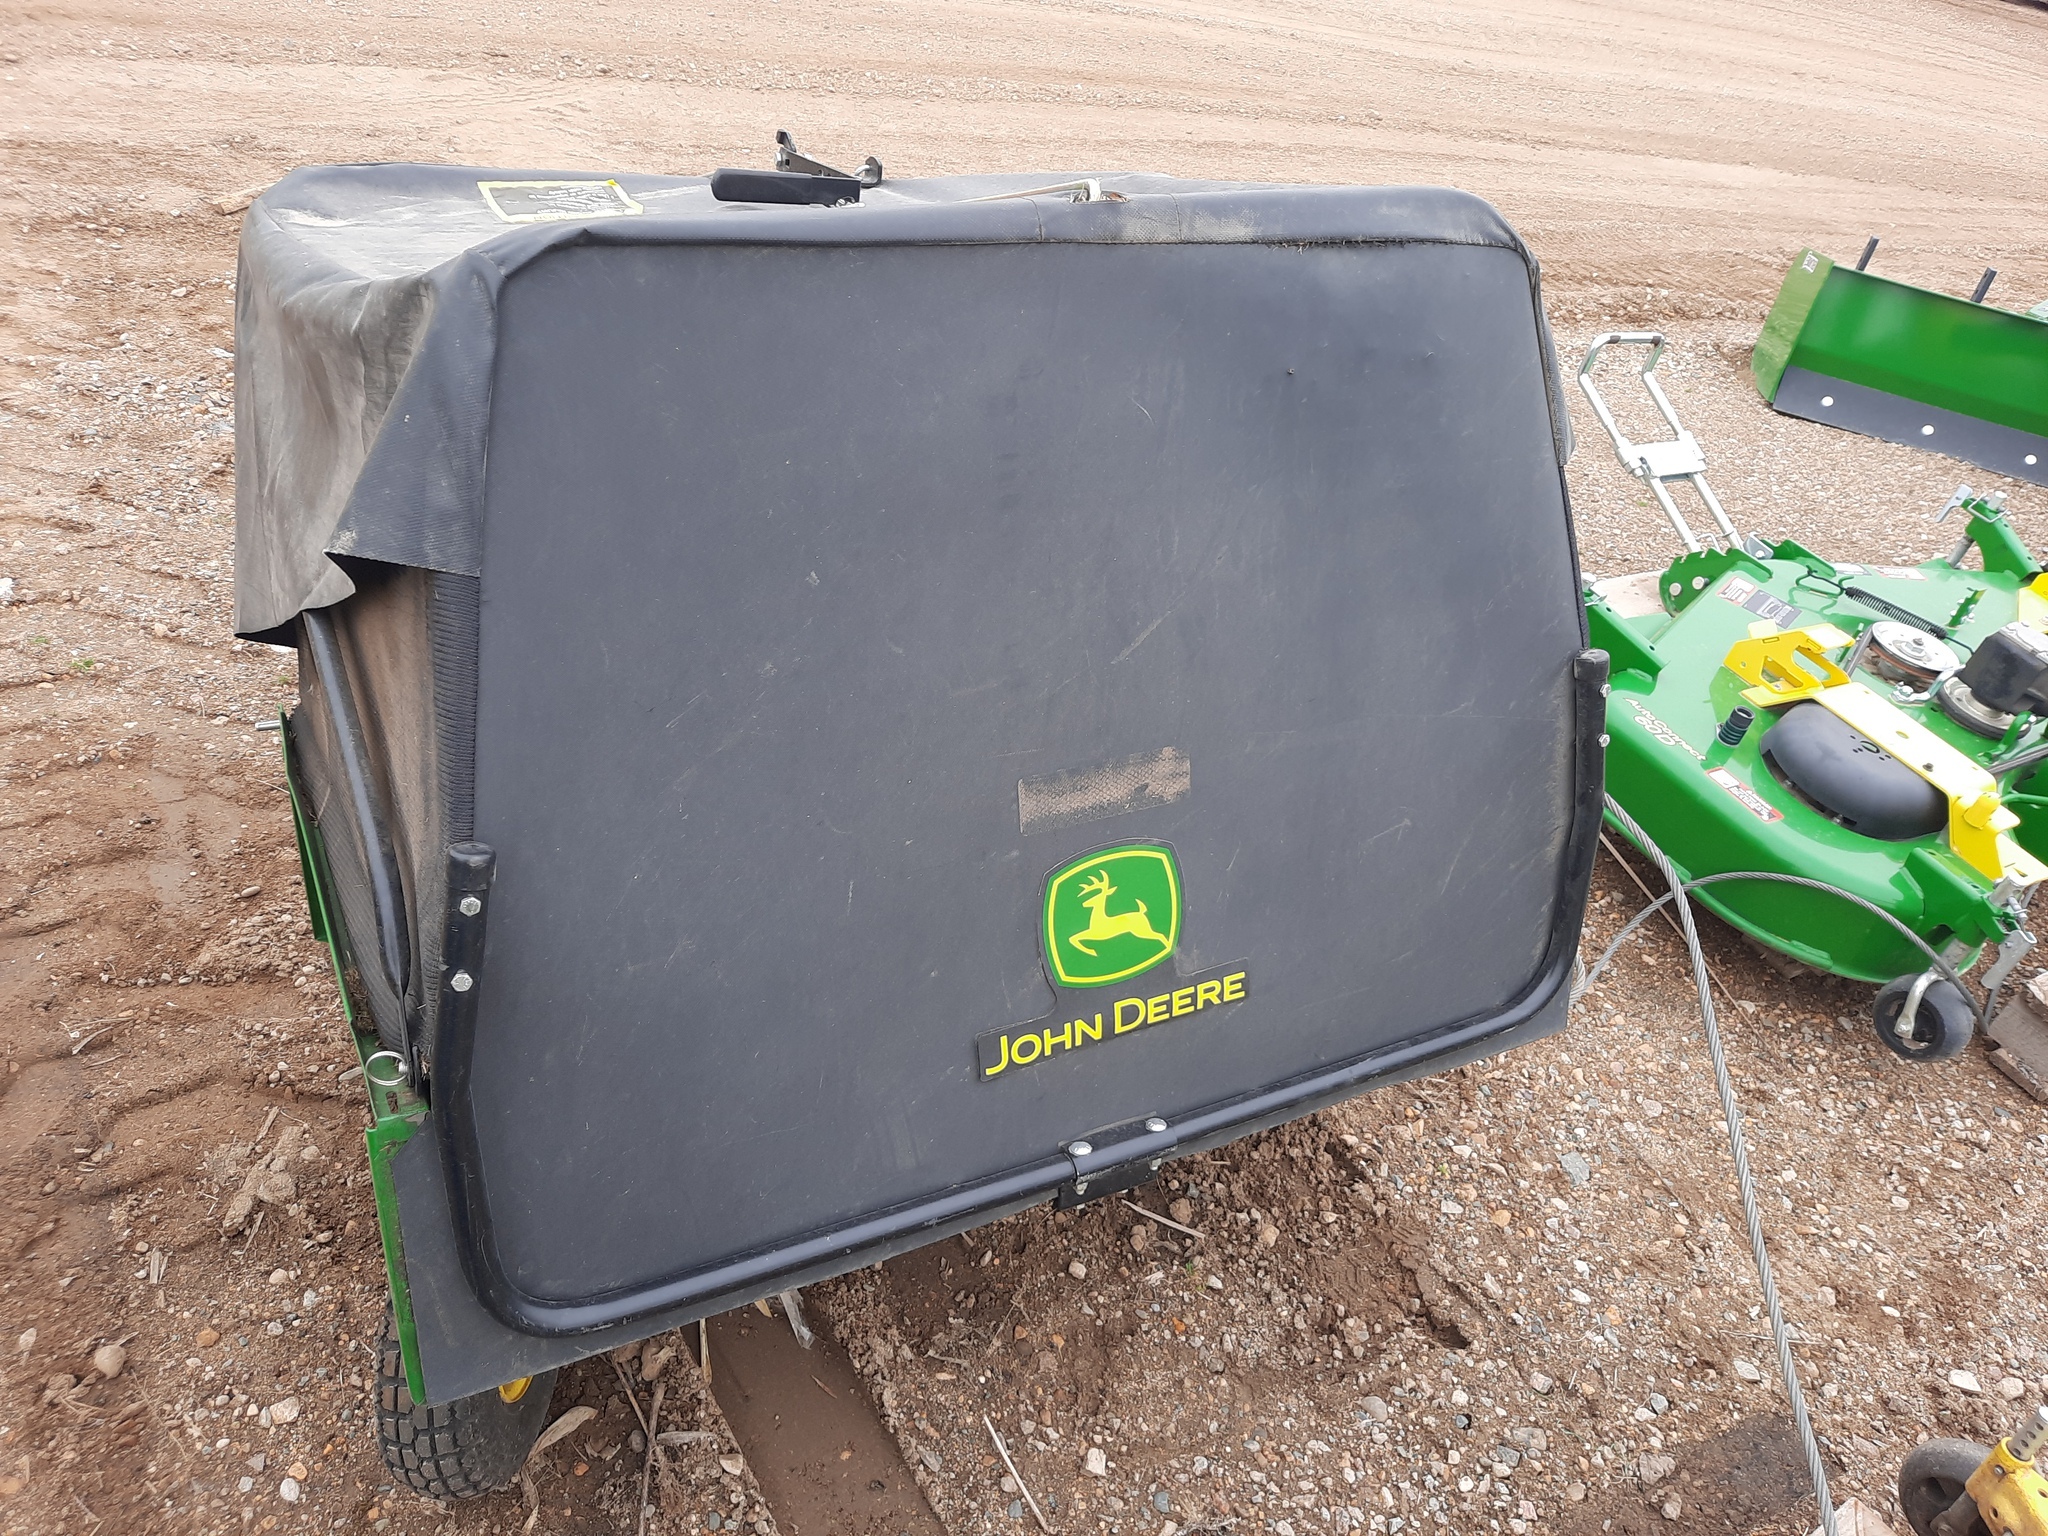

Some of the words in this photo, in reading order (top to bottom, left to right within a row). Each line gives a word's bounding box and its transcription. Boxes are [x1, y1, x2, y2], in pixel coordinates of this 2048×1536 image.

[1623, 697, 1707, 761] AutoConnect
[1633, 714, 1677, 747] 60D
[985, 1013, 1102, 1076] JOHN
[1113, 971, 1246, 1035] DEERE
